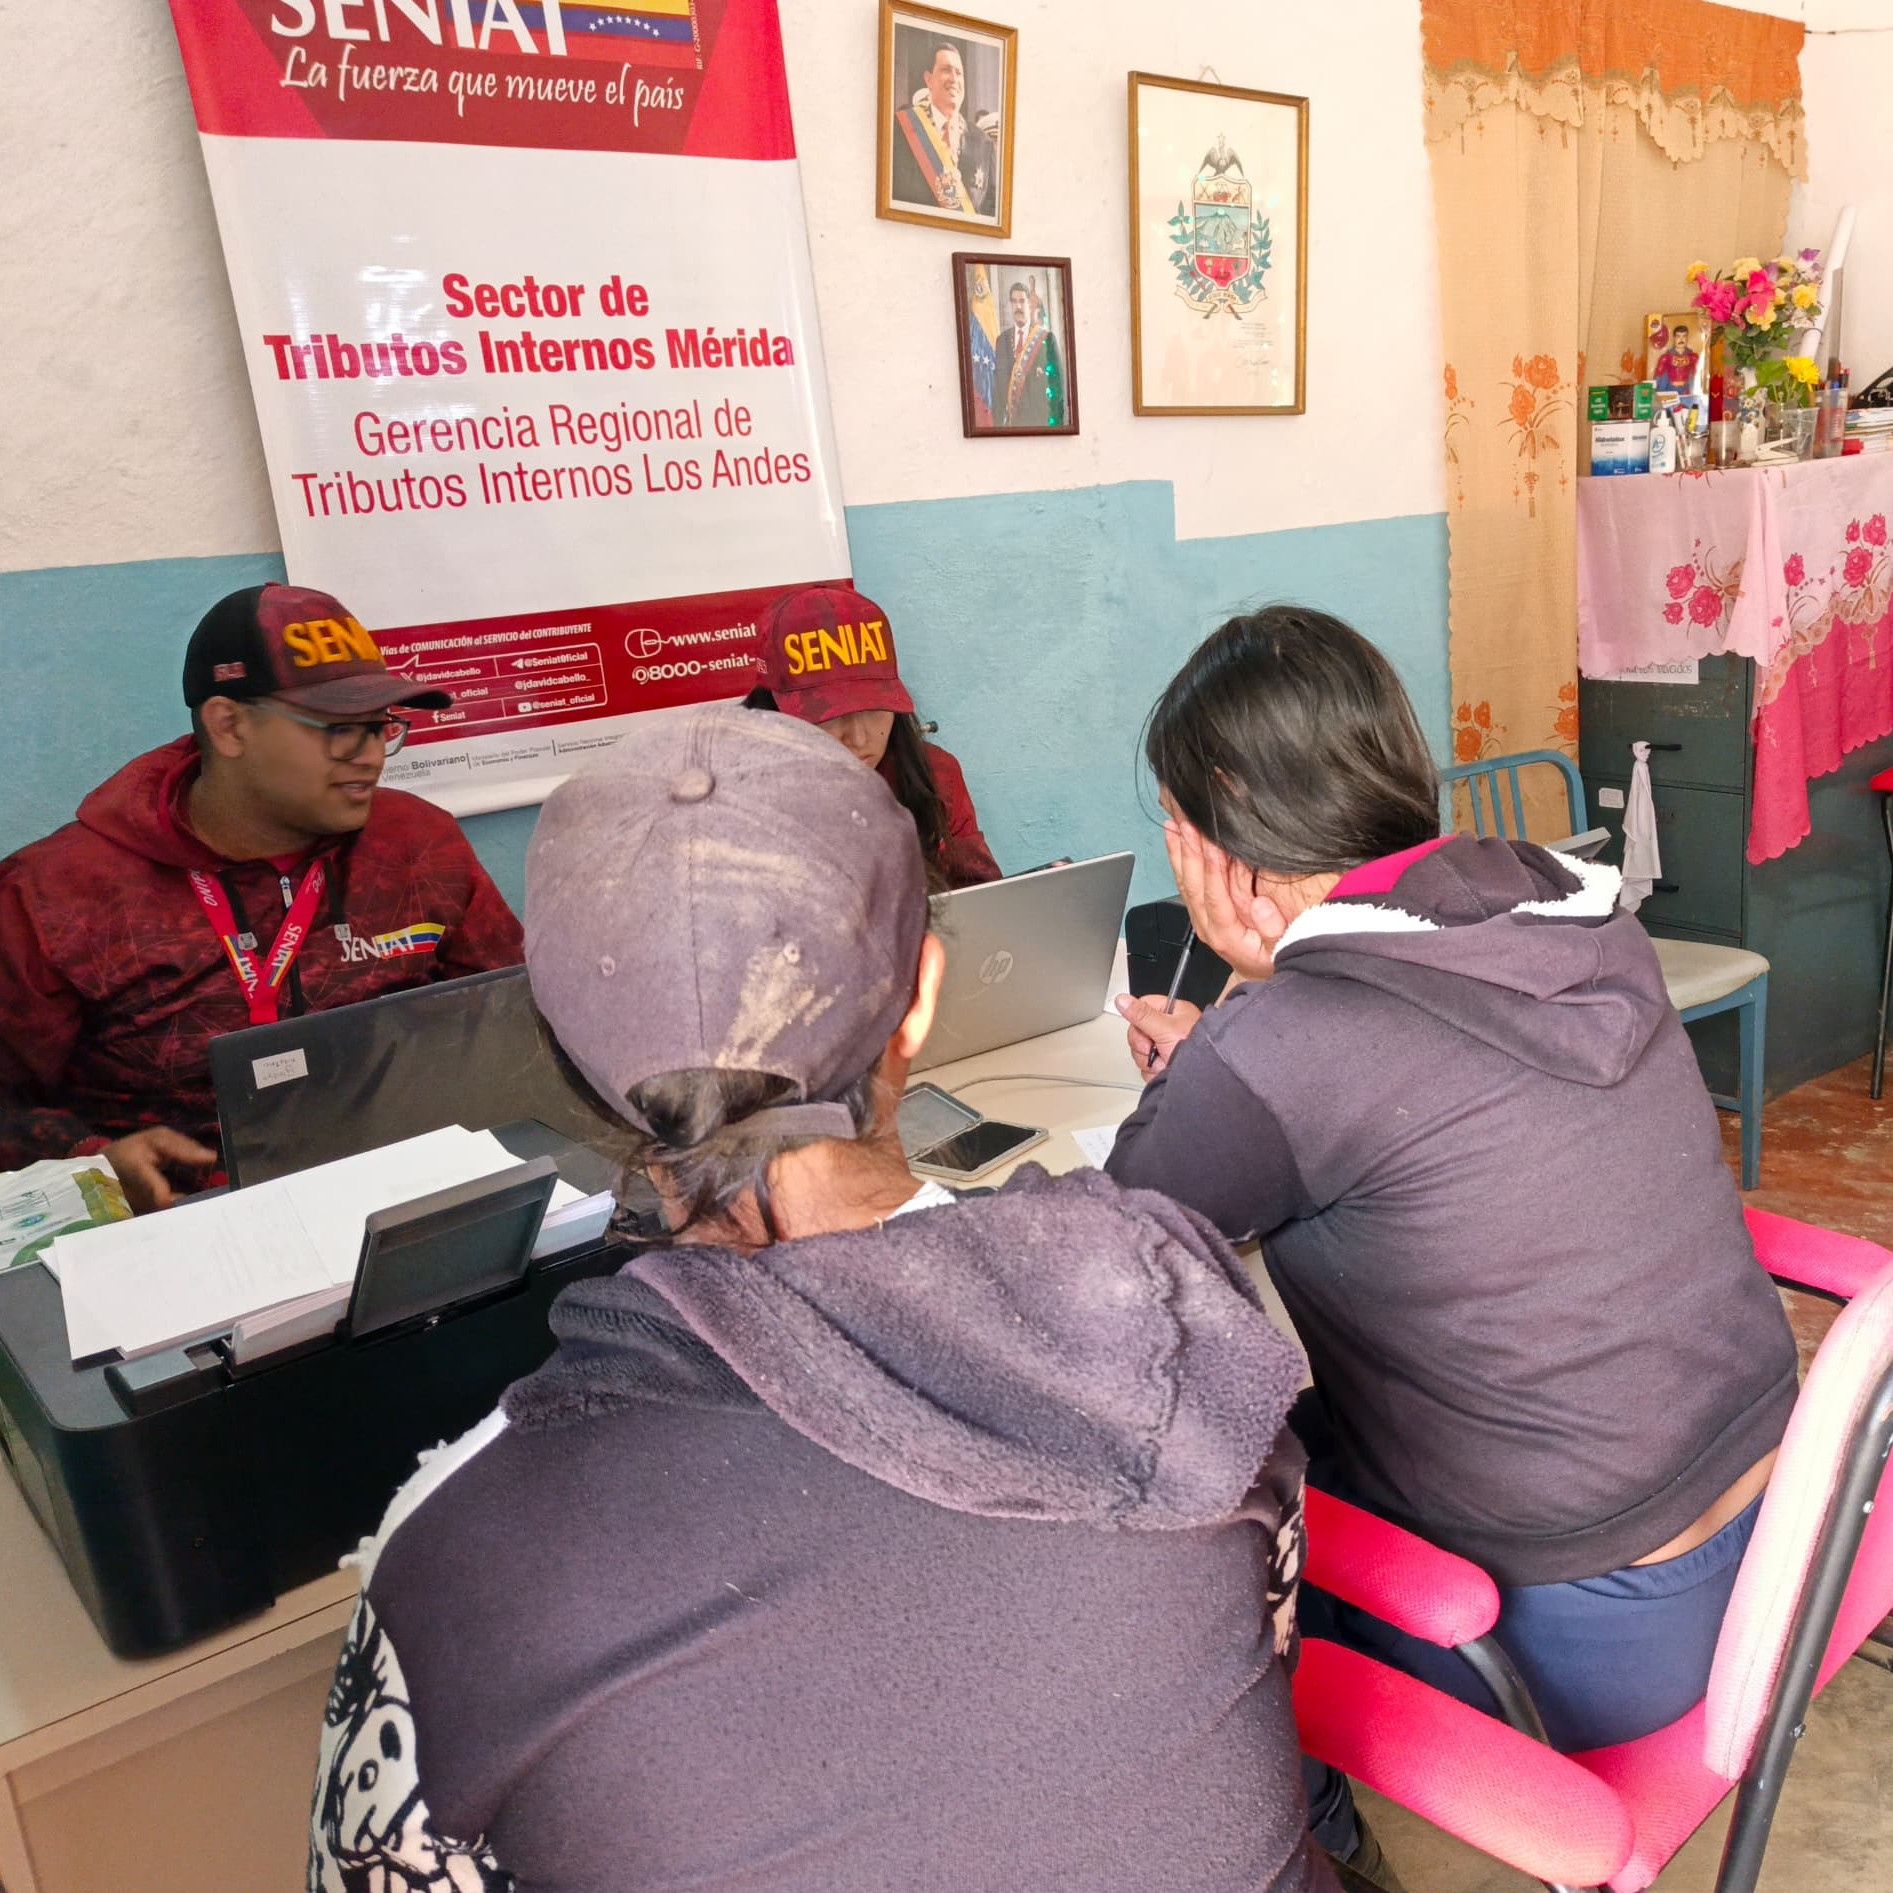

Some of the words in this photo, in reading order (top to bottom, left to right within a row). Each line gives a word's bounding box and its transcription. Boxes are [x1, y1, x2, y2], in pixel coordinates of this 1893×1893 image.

[280, 44, 328, 90] La
[337, 44, 439, 100] fuerza
[449, 68, 498, 116] que
[506, 75, 597, 104] mueve
[606, 63, 626, 104] el
[633, 76, 685, 126] país
[442, 273, 584, 319] Sector
[600, 275, 649, 317] de
[263, 333, 467, 380] Tributos
[479, 330, 656, 374] Internos
[665, 326, 795, 369] Mérida
[354, 406, 540, 457] Gerencia
[549, 398, 701, 453] Regional
[714, 397, 752, 437] de
[291, 468, 467, 518] Tributos
[479, 461, 633, 505] Internos
[643, 452, 700, 493] Los
[712, 446, 811, 489] Andes
[399, 644, 410, 655] de
[410, 635, 473, 653] COMUNICACIÓN
[483, 632, 518, 646] SERVICIO
[519, 630, 532, 641] del
[533, 623, 592, 639] CONTRIBUYENTE
[671, 622, 757, 647] www.seniat
[784, 621, 888, 676] SENIAT
[440, 711, 466, 722] Seniat
[411, 754, 467, 771] Bolivariano
[270, 922, 303, 967] SENIAT
[340, 929, 417, 964] SENIAT
